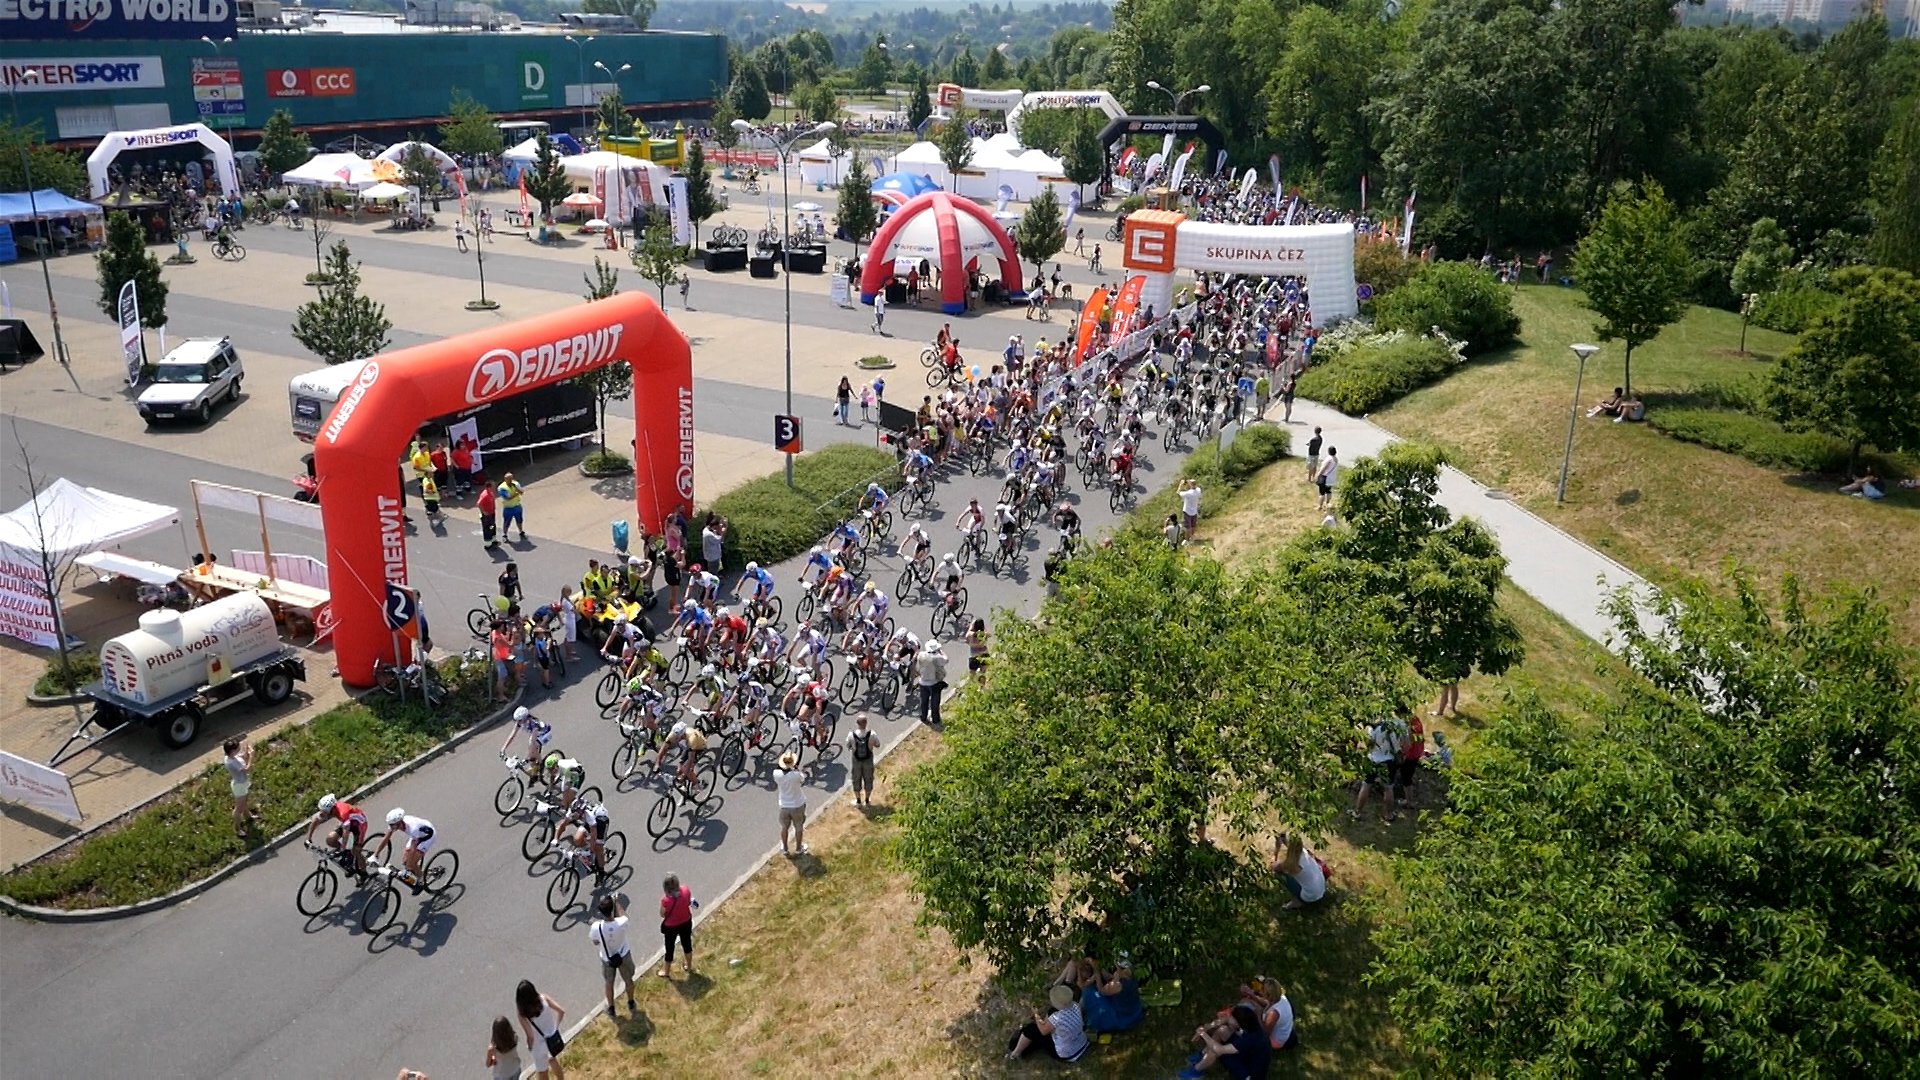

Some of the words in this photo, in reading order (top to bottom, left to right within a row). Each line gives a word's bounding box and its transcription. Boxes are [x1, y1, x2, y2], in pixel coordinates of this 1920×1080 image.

[121, 0, 229, 22] WORLD
[3, 63, 140, 85] INTERSPORT
[315, 73, 351, 90] CCC
[524, 61, 545, 90] D
[137, 129, 199, 146] INTERSPORT
[1142, 122, 1198, 131] GENESIS
[1206, 247, 1273, 262] SKUPINA
[1277, 246, 1305, 262] ČEZ
[516, 323, 624, 388] ENERVIT
[325, 383, 367, 444] ENERVIT
[678, 386, 693, 465] ENERVIT
[780, 419, 794, 440] 3
[391, 590, 409, 620] 2
[146, 645, 184, 669] Pitná
[186, 634, 220, 654] voda
